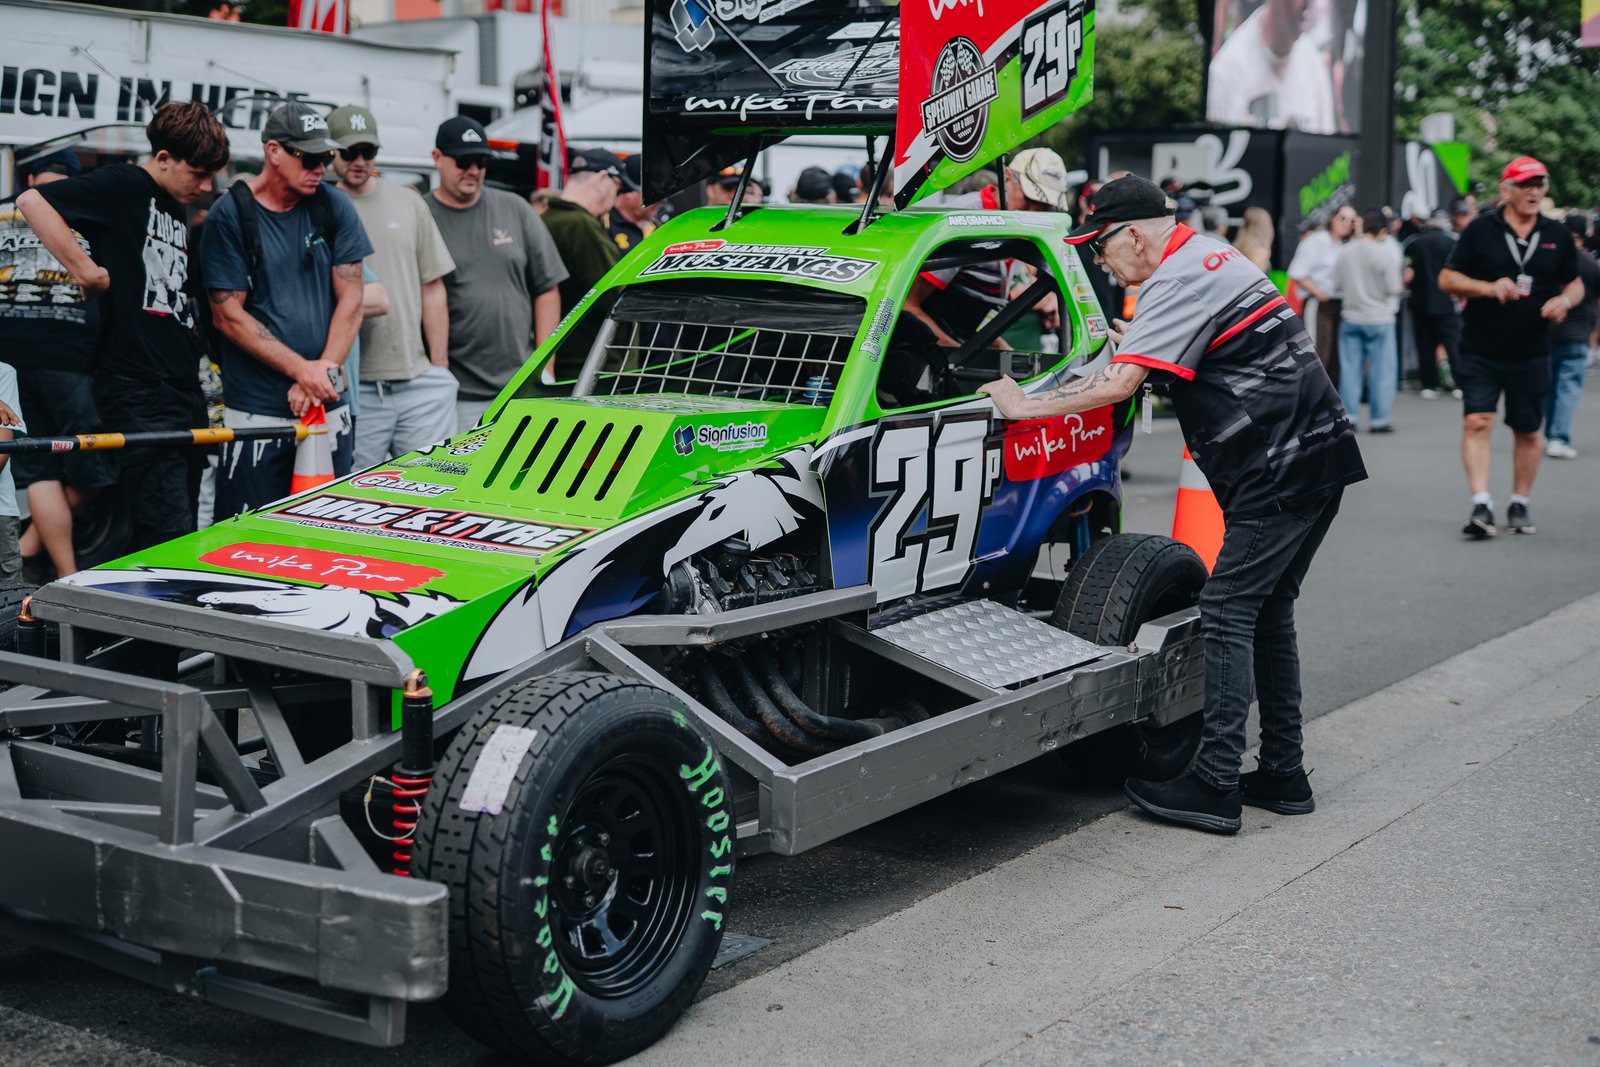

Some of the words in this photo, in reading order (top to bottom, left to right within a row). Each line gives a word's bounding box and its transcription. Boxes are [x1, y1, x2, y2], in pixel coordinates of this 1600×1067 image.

[924, 89, 967, 129] SPEEDWAY
[966, 71, 996, 109] GARAGE
[966, 215, 1006, 226] GRAPHICS
[718, 245, 826, 255] MANAWATU
[650, 253, 867, 281] MUSTANGS
[699, 423, 767, 445] Signfusion
[358, 477, 457, 495] GIANT
[284, 497, 414, 525] MAG
[392, 510, 449, 531] &
[438, 515, 582, 550] TYRE
